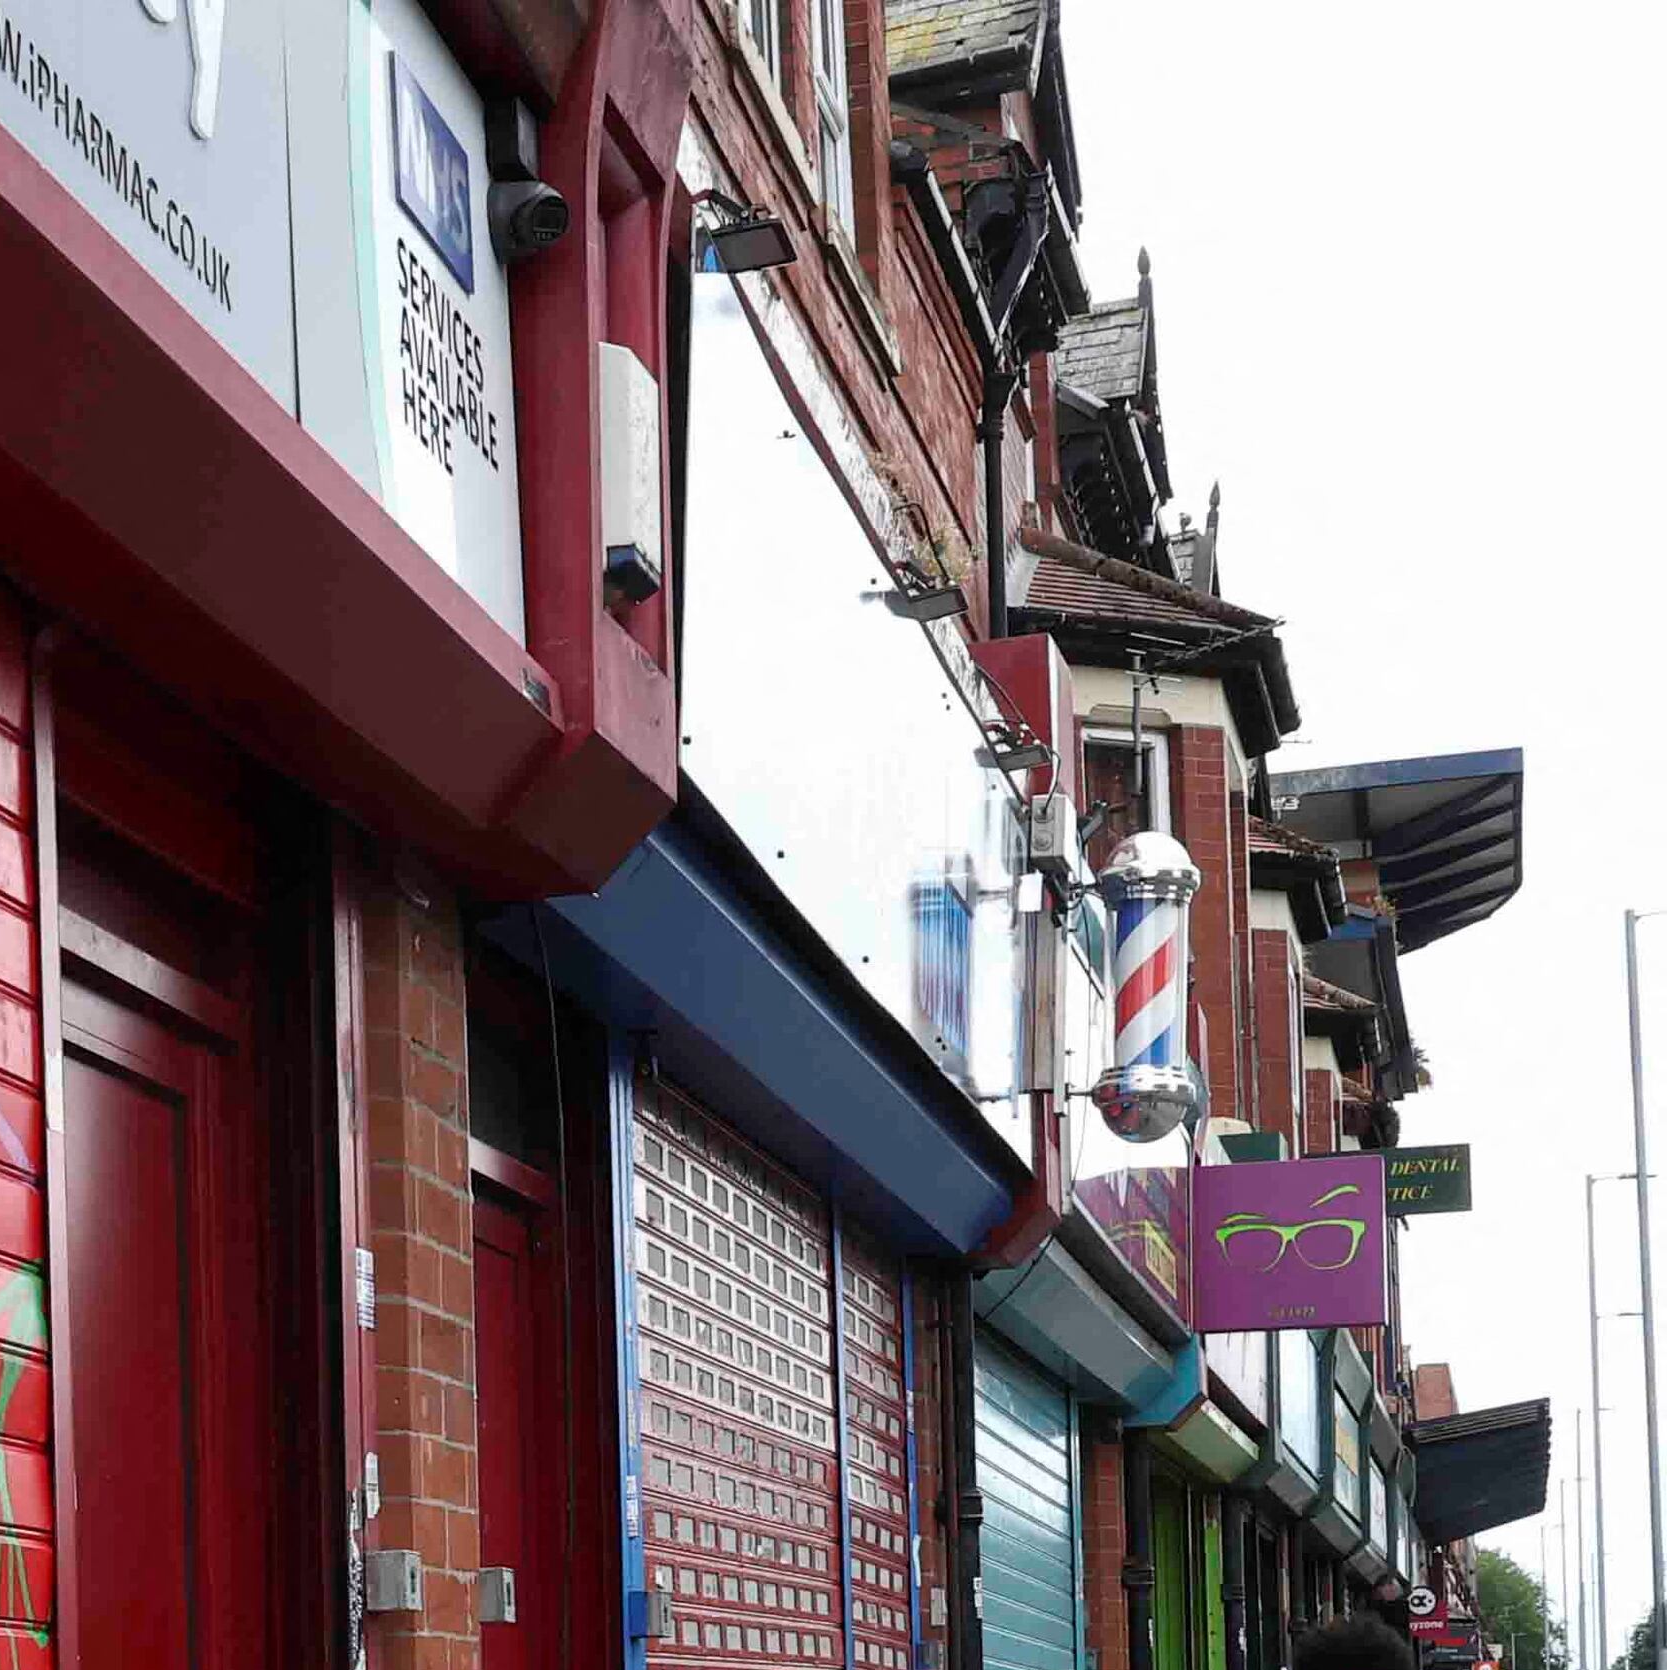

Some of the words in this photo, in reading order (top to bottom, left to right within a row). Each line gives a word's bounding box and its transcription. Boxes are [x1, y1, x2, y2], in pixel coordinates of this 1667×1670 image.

[400, 84, 468, 256] NHS
[397, 237, 483, 392] SERVICES
[400, 305, 499, 472] AVAILABLE
[402, 367, 453, 476] HERE
[1387, 1183, 1435, 1201] TICE
[1390, 1158, 1460, 1176] DENTAL
